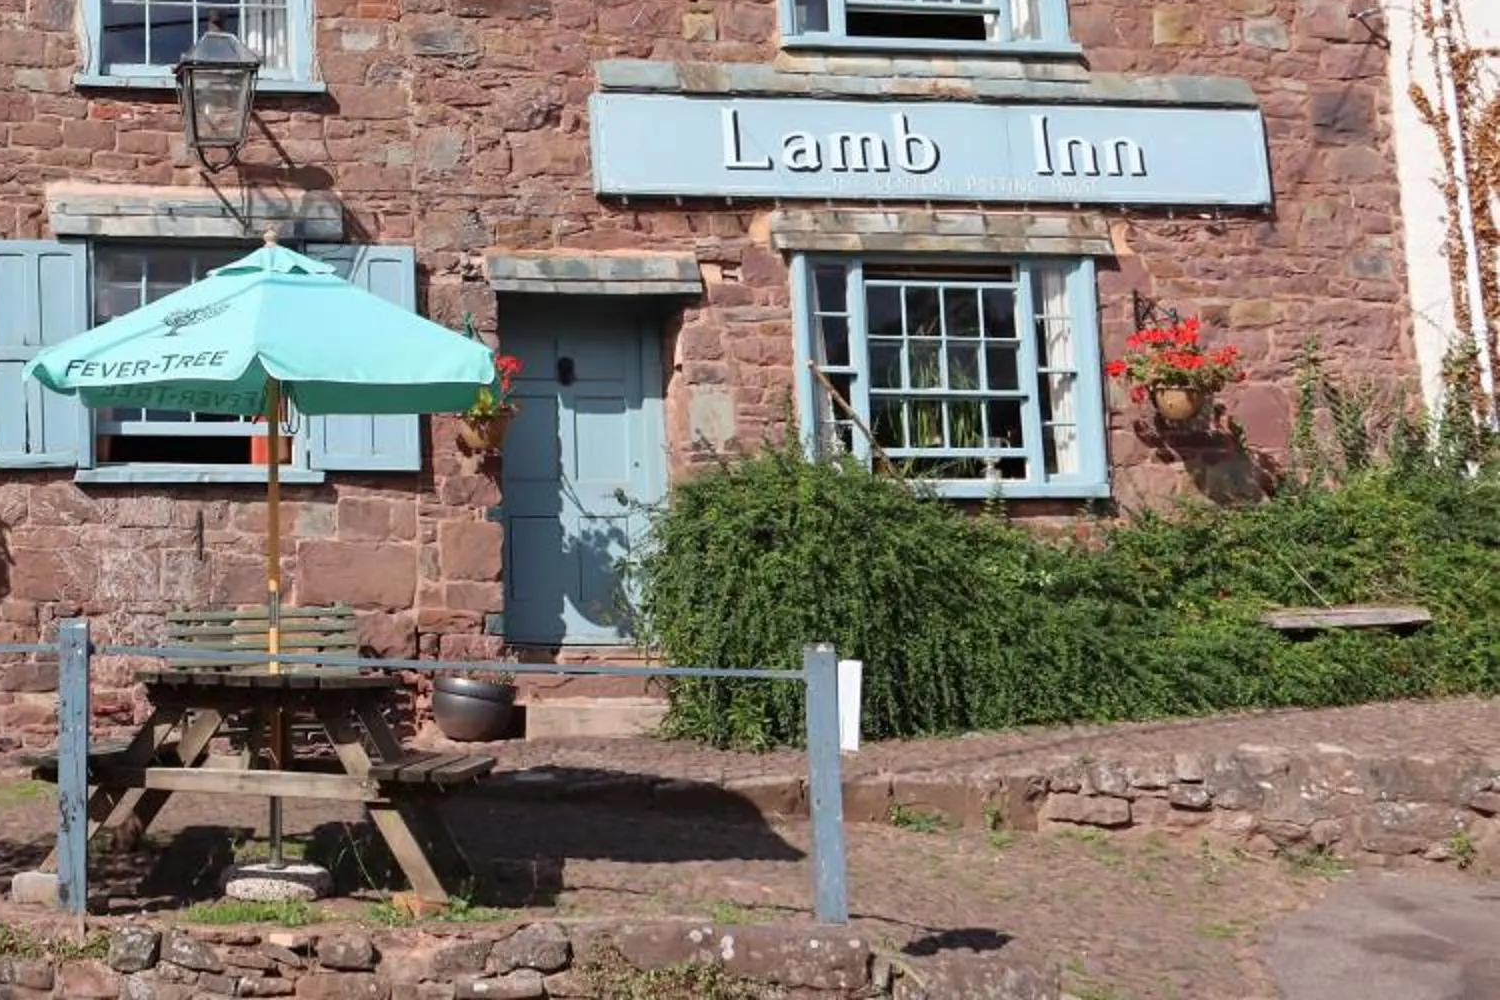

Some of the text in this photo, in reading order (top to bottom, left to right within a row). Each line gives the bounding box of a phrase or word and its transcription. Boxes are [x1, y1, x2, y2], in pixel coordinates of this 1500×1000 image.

[721, 107, 1148, 178] Lamb Inn
[65, 350, 228, 378] FEVER-TREE
